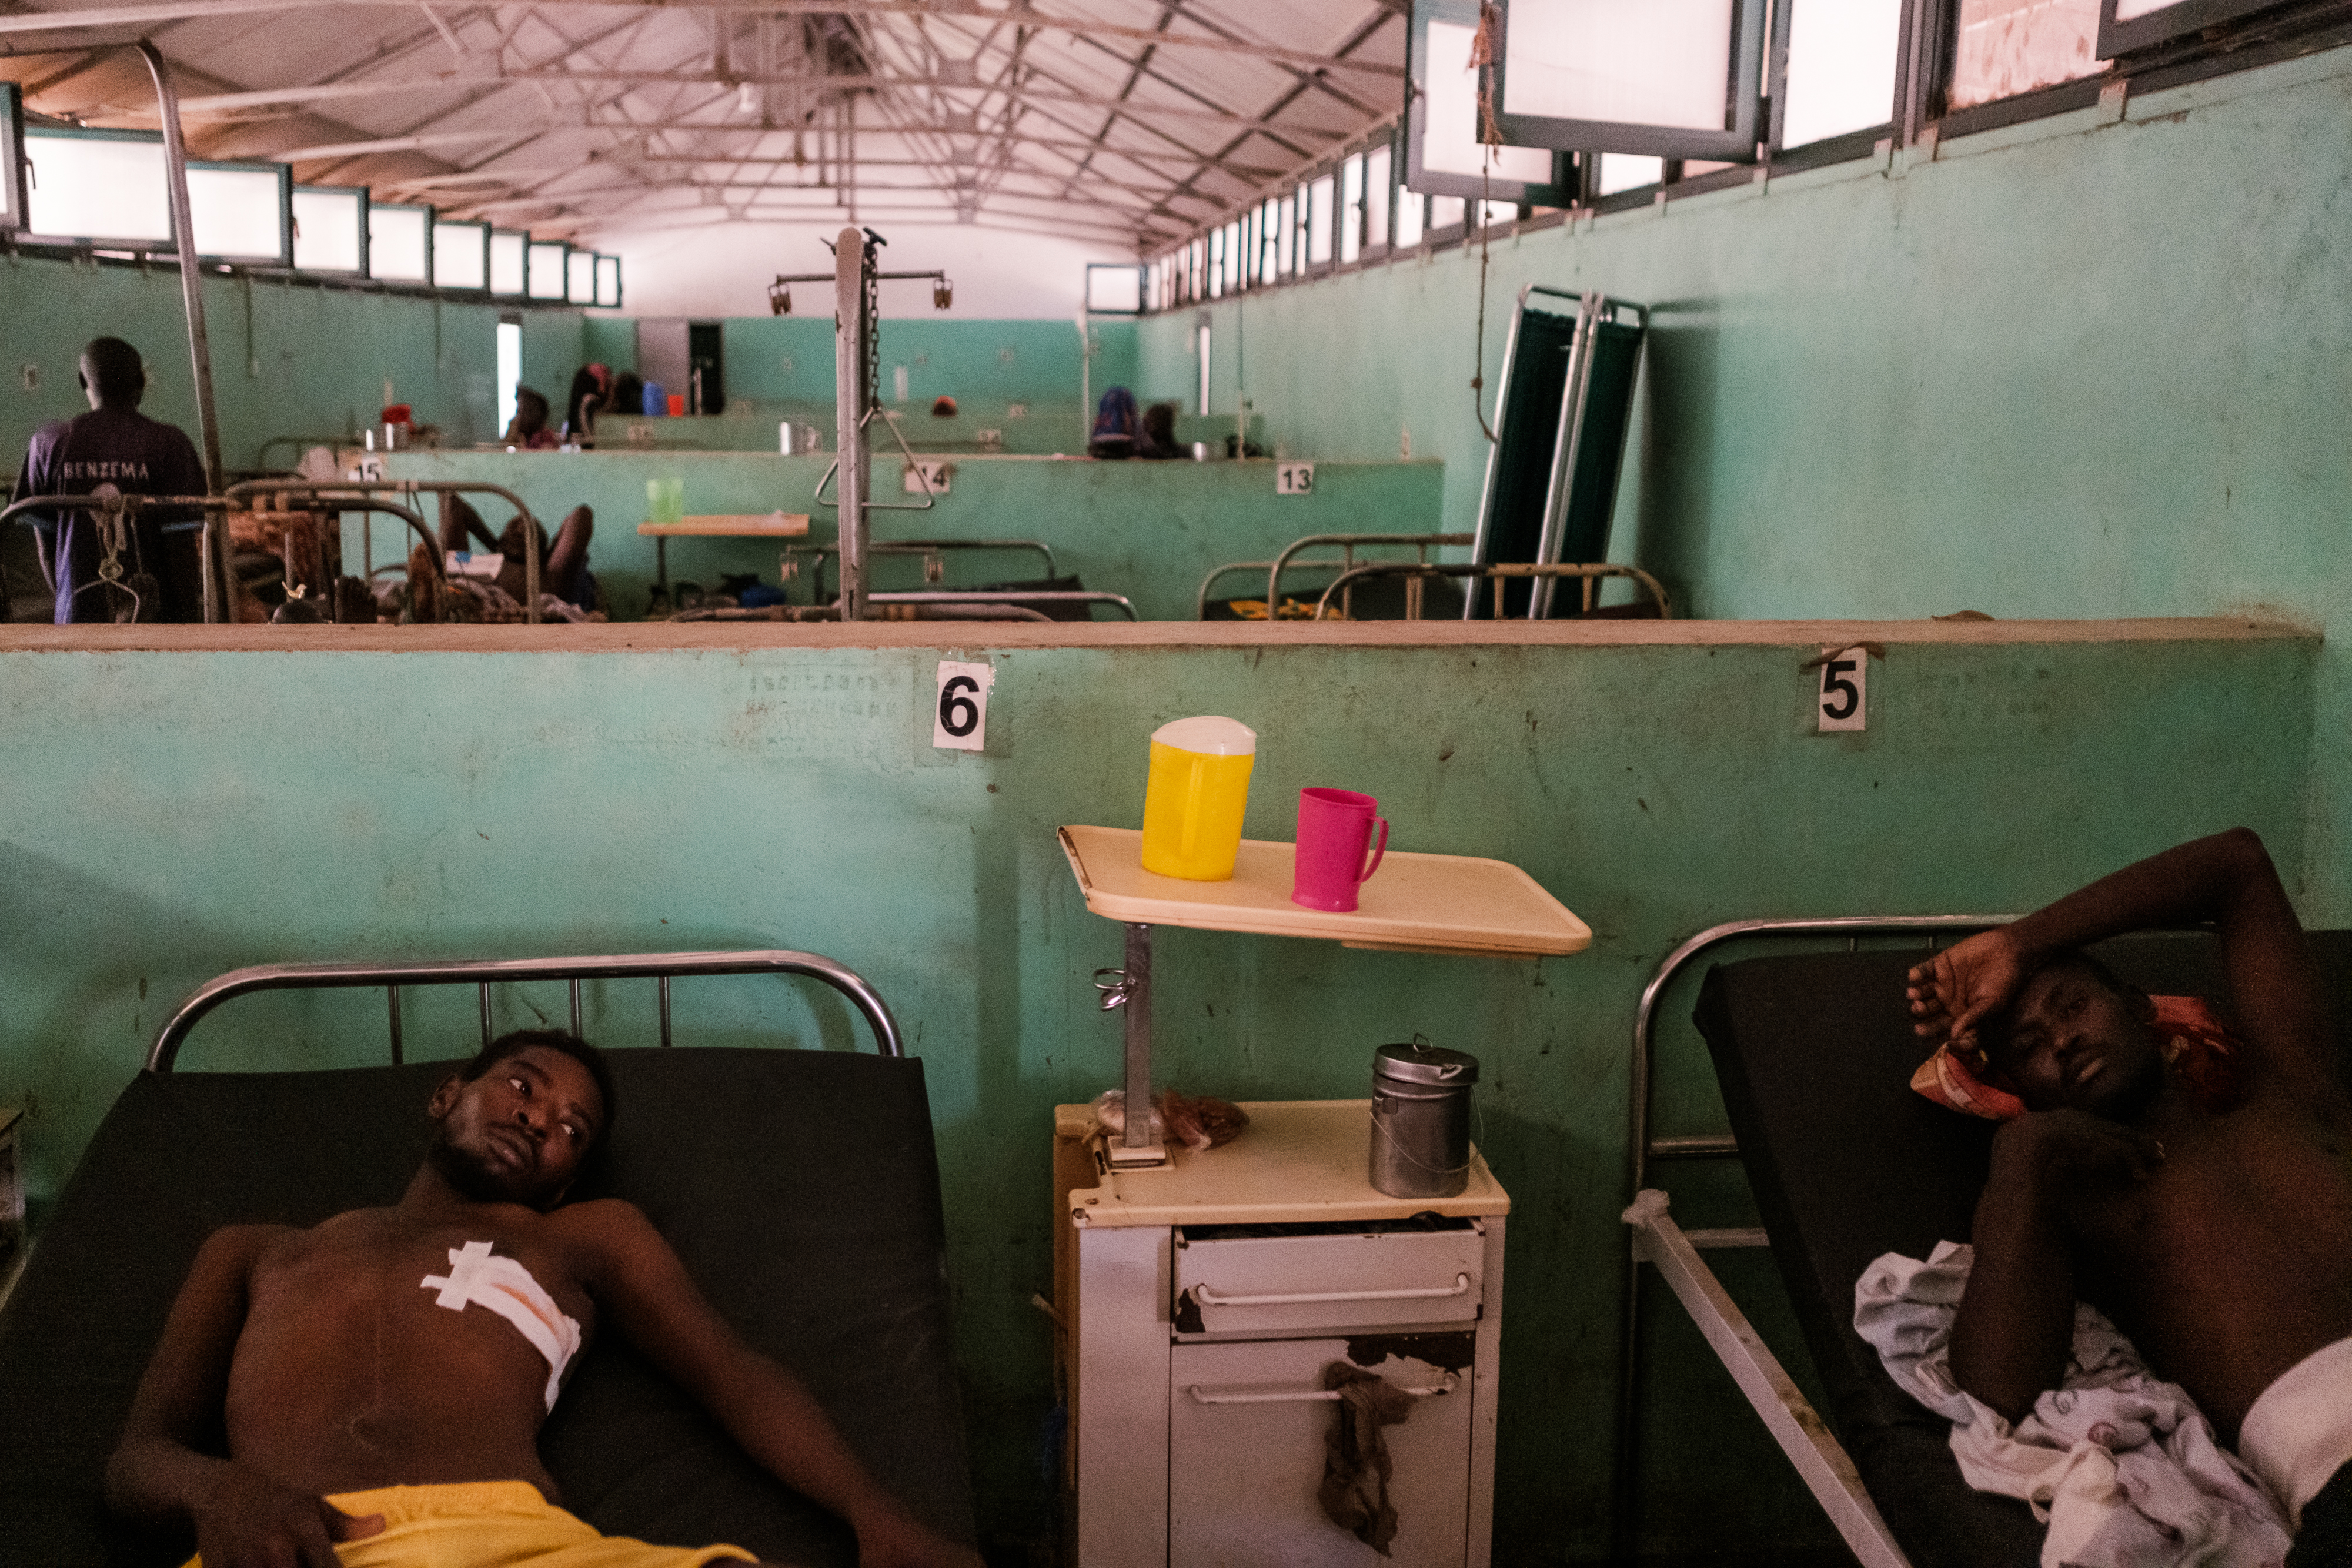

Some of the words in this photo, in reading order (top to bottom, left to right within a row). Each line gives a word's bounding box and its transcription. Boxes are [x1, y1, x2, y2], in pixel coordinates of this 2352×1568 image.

[64, 462, 148, 479] BENZEMA
[1284, 469, 1311, 489] 13
[940, 676, 980, 737] 6
[1822, 660, 1858, 720] 5
